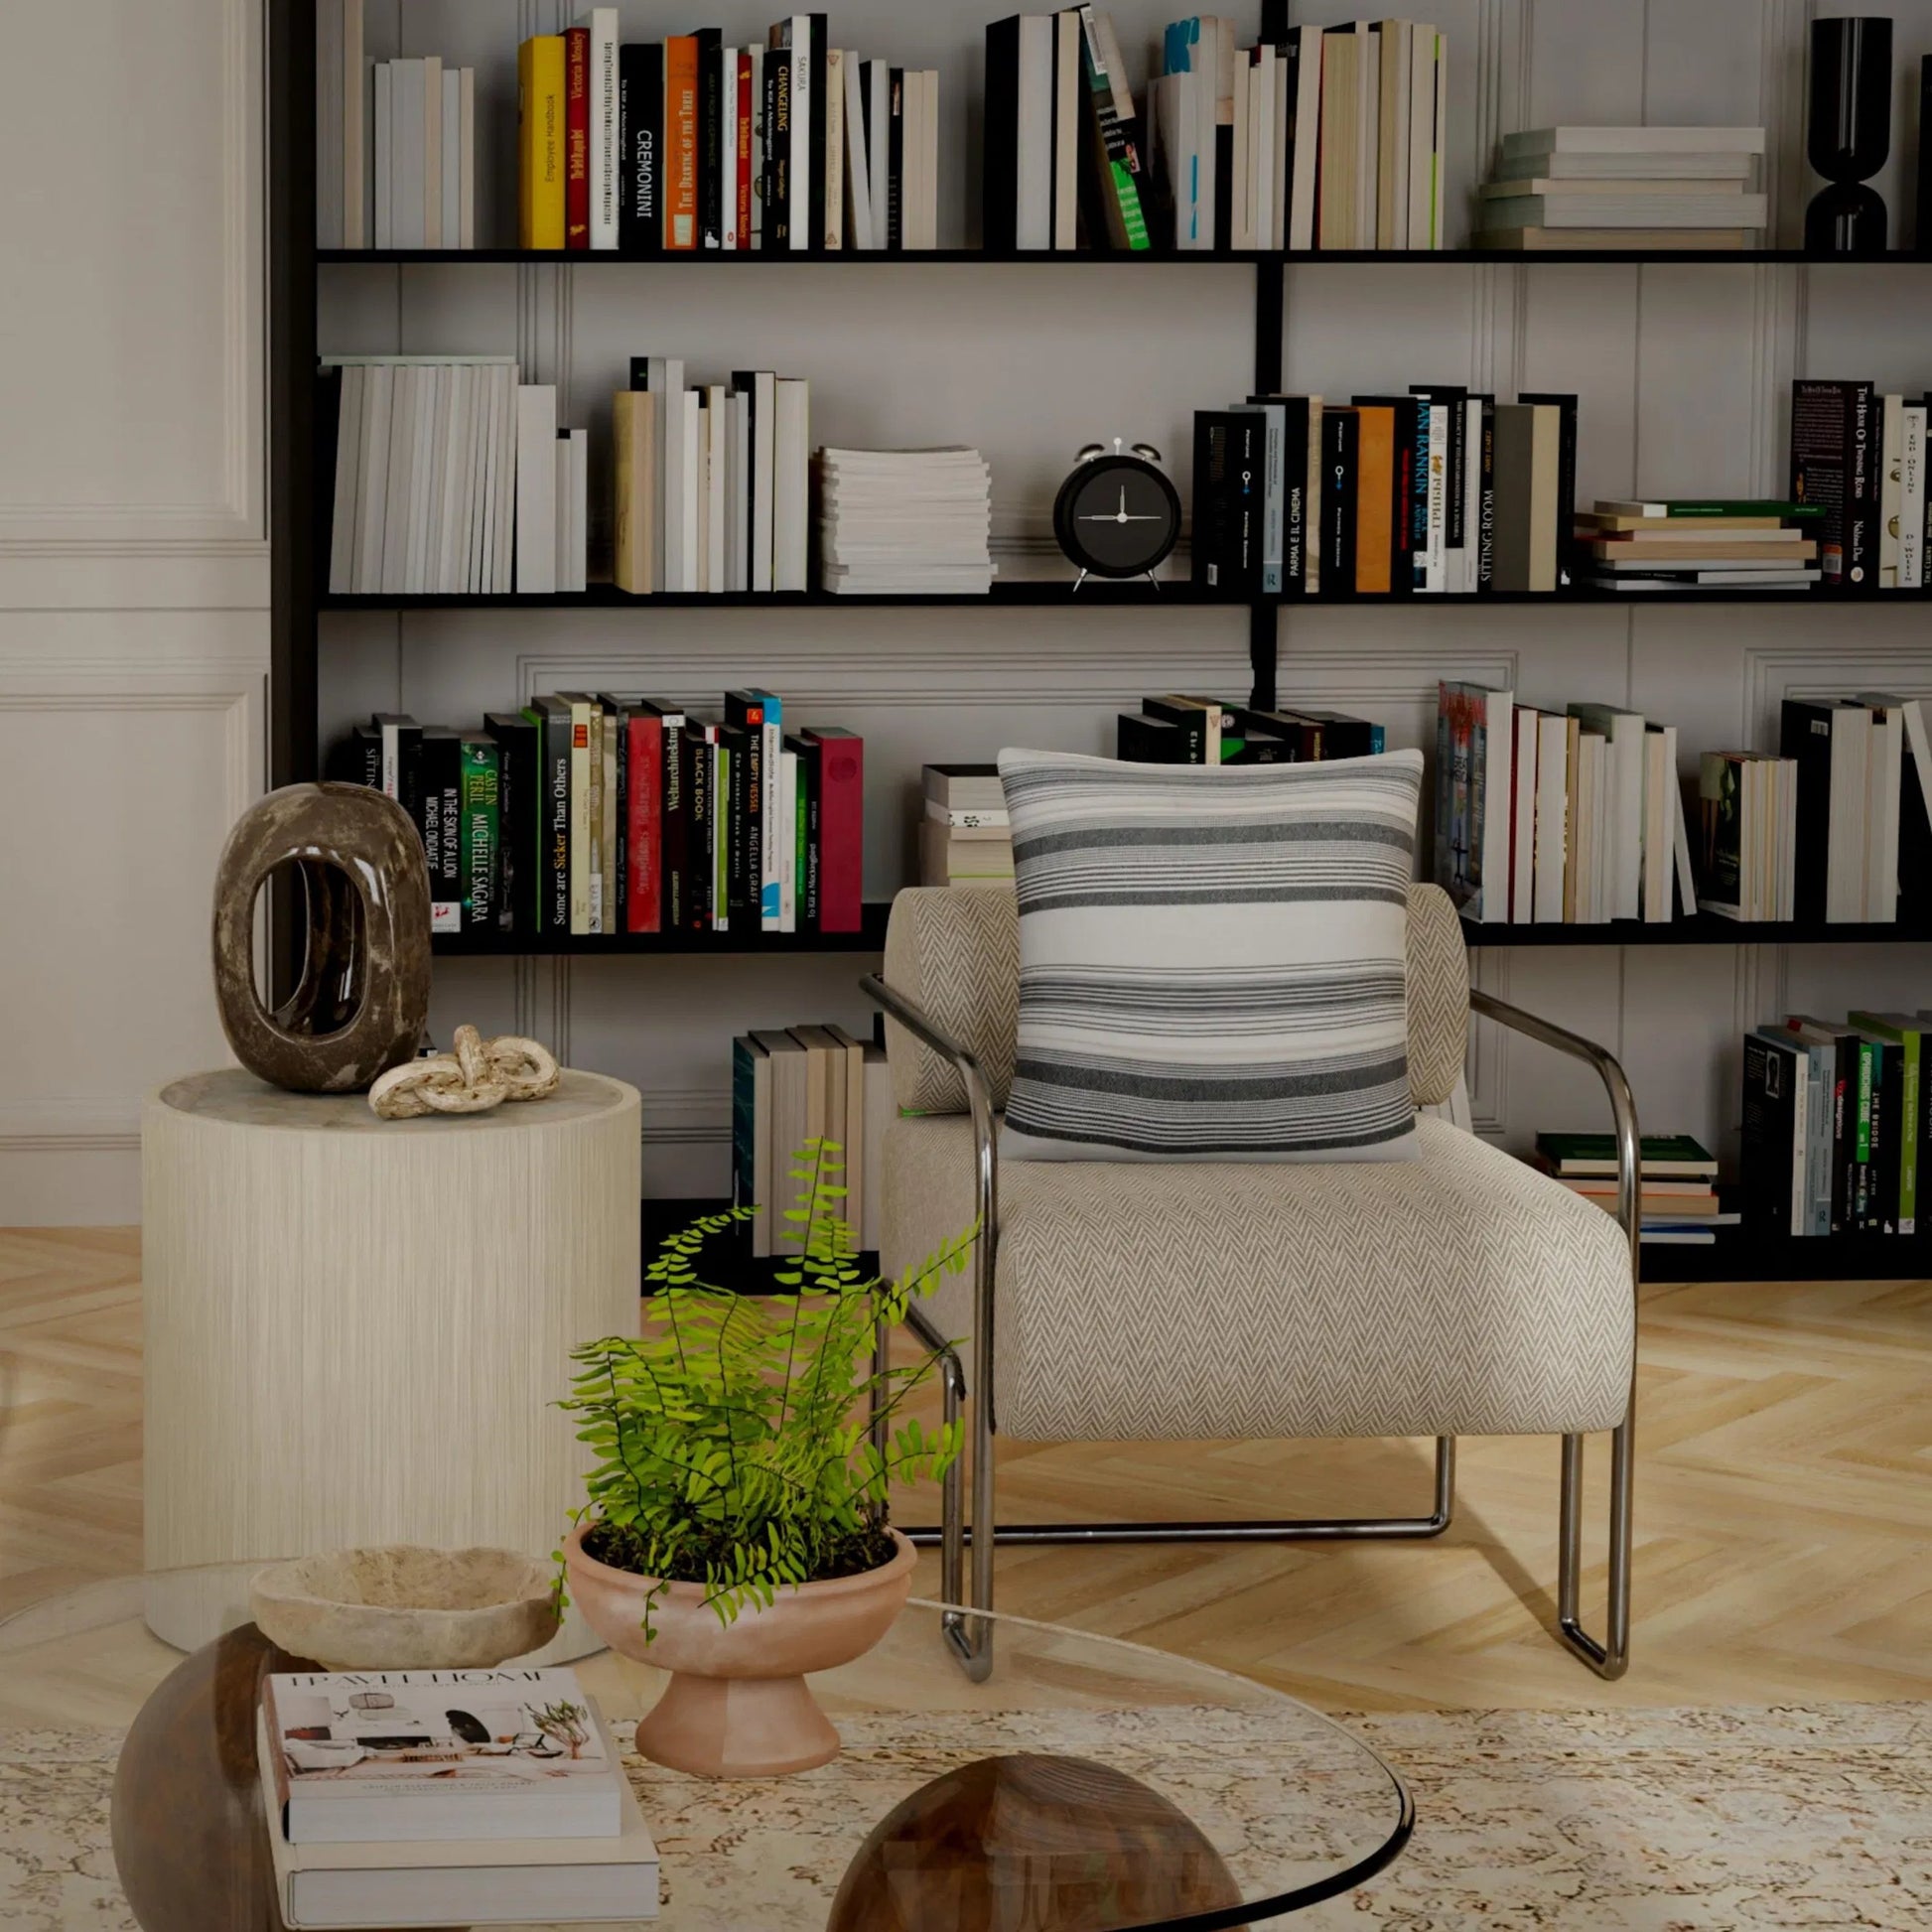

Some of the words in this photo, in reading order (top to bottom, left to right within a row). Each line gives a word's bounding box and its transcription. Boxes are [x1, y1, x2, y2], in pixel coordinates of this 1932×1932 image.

[570, 32, 586, 64] Mosley
[570, 65, 584, 100] Victoria
[766, 79, 773, 88] To
[796, 57, 806, 91] SAKURA
[679, 89, 693, 117] THREE
[777, 66, 789, 132] CHANGELING
[544, 93, 556, 138] Handbook
[680, 119, 693, 135] THE
[680, 138, 693, 149] OF
[764, 111, 773, 161] Mockingbird
[544, 140, 557, 183] Employee
[636, 129, 652, 218] CREMONINI
[679, 192, 693, 209] THE
[1857, 386, 1867, 402] THE
[1415, 402, 1430, 430] IAN
[1856, 404, 1867, 427] HOUSE
[1855, 429, 1866, 441] OF
[1414, 434, 1429, 494] RANKIN
[1854, 443, 1866, 476] TWINING
[1432, 478, 1443, 529] ГРИБЫ
[1854, 477, 1865, 499] ROSES
[1290, 486, 1302, 523] CINEMA
[1481, 489, 1493, 529] ROOM
[1290, 525, 1301, 534] IL
[1289, 546, 1300, 577] PARMA
[1480, 531, 1493, 582] SITTING
[749, 735, 759, 751] THE
[365, 747, 376, 787] SITTIN
[484, 769, 497, 794] CAST
[553, 758, 567, 798] Others
[667, 726, 680, 811] Weltarchitektur
[694, 749, 705, 785] BLACK
[749, 752, 759, 781] EMPTY
[443, 787, 458, 797] IN
[470, 775, 484, 803] PERIL
[484, 795, 497, 805] IN
[694, 788, 705, 821] BOOK
[749, 782, 759, 813] VESSEL
[425, 796, 439, 830] MICHAEL
[443, 798, 458, 816] THE
[553, 800, 567, 831] Than
[443, 817, 458, 836] SKIN
[443, 837, 458, 850] OF
[472, 814, 488, 874] MICHELLE
[553, 833, 567, 870] Sicker
[749, 826, 759, 870] ANGELLA
[443, 858, 458, 879] LION
[556, 871, 567, 891] are
[807, 843, 818, 889] Mockingbird
[471, 877, 488, 924] SAGARA
[749, 873, 759, 904] GRAFF
[807, 896, 817, 908] Kill
[553, 893, 567, 925] Some
[807, 908, 817, 918] To
